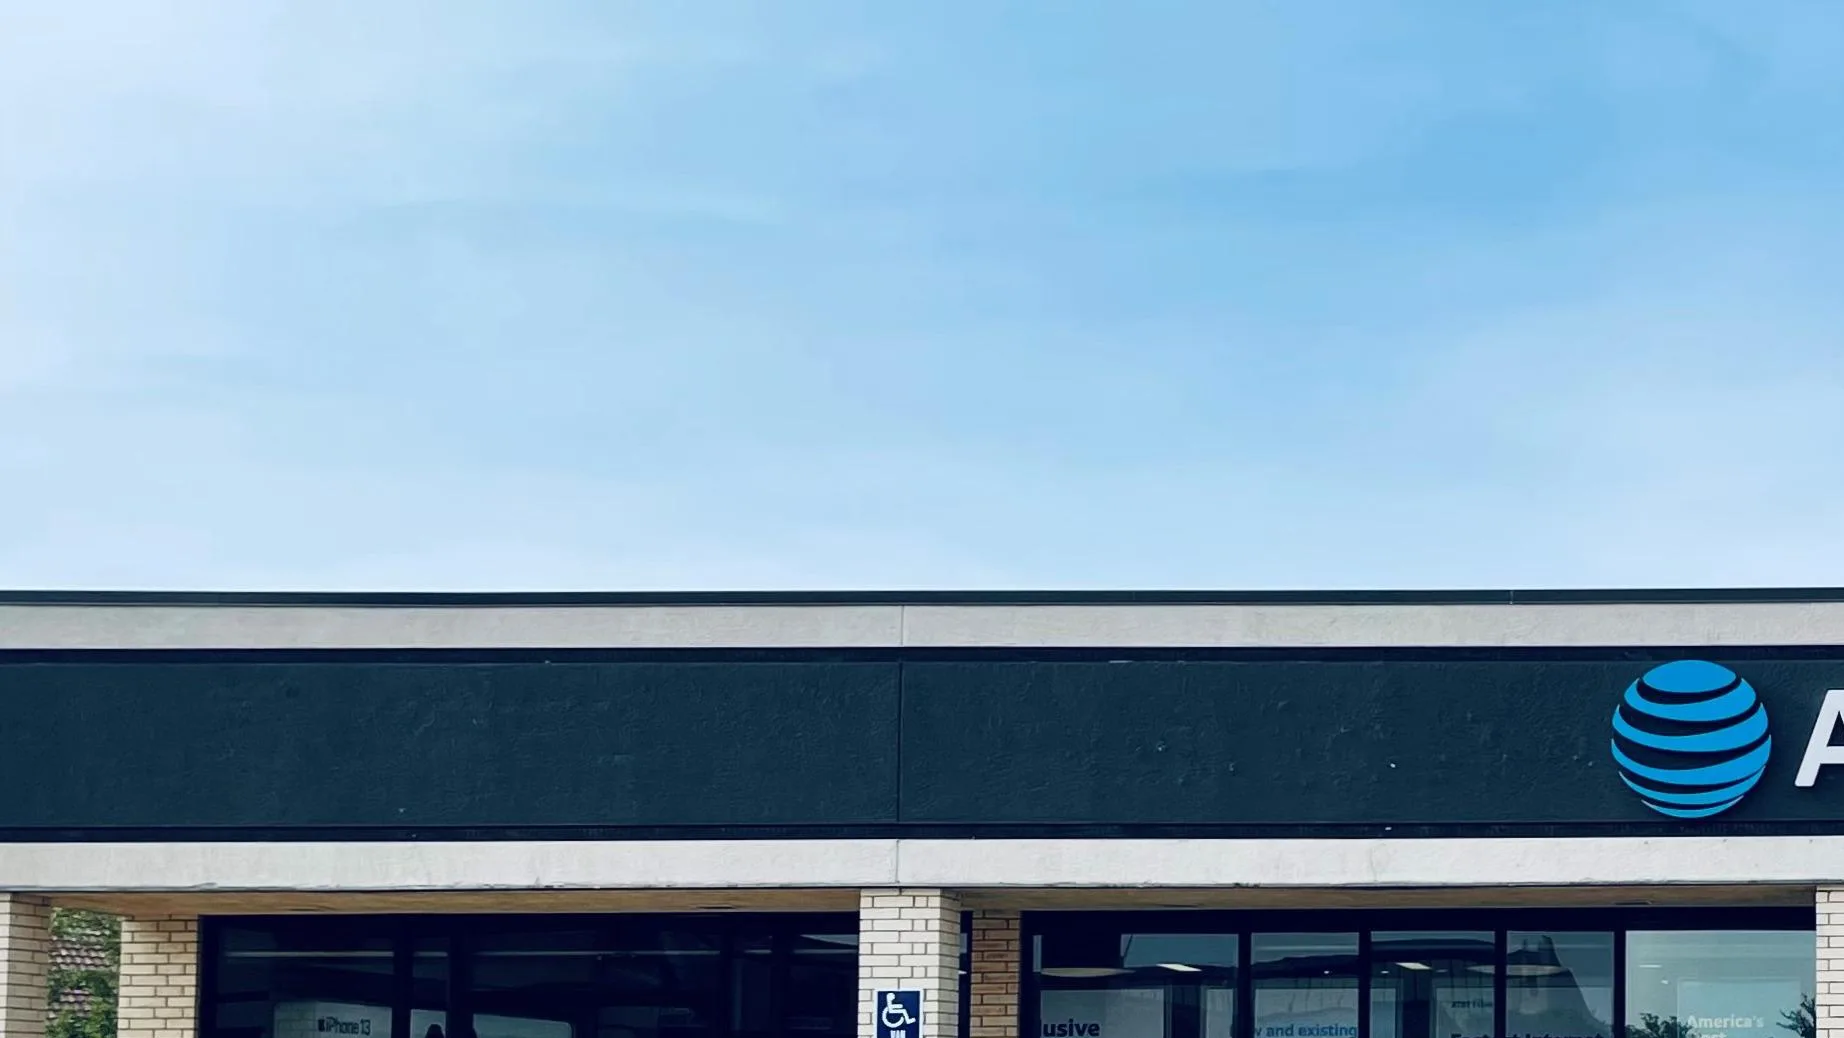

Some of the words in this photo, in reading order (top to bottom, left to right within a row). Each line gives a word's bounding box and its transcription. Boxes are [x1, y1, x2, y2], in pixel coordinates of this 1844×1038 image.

[326, 1016, 359, 1034] iPhone
[360, 1019, 371, 1035] 13
[1686, 1014, 1765, 1028] America's
[1266, 1023, 1294, 1037] and
